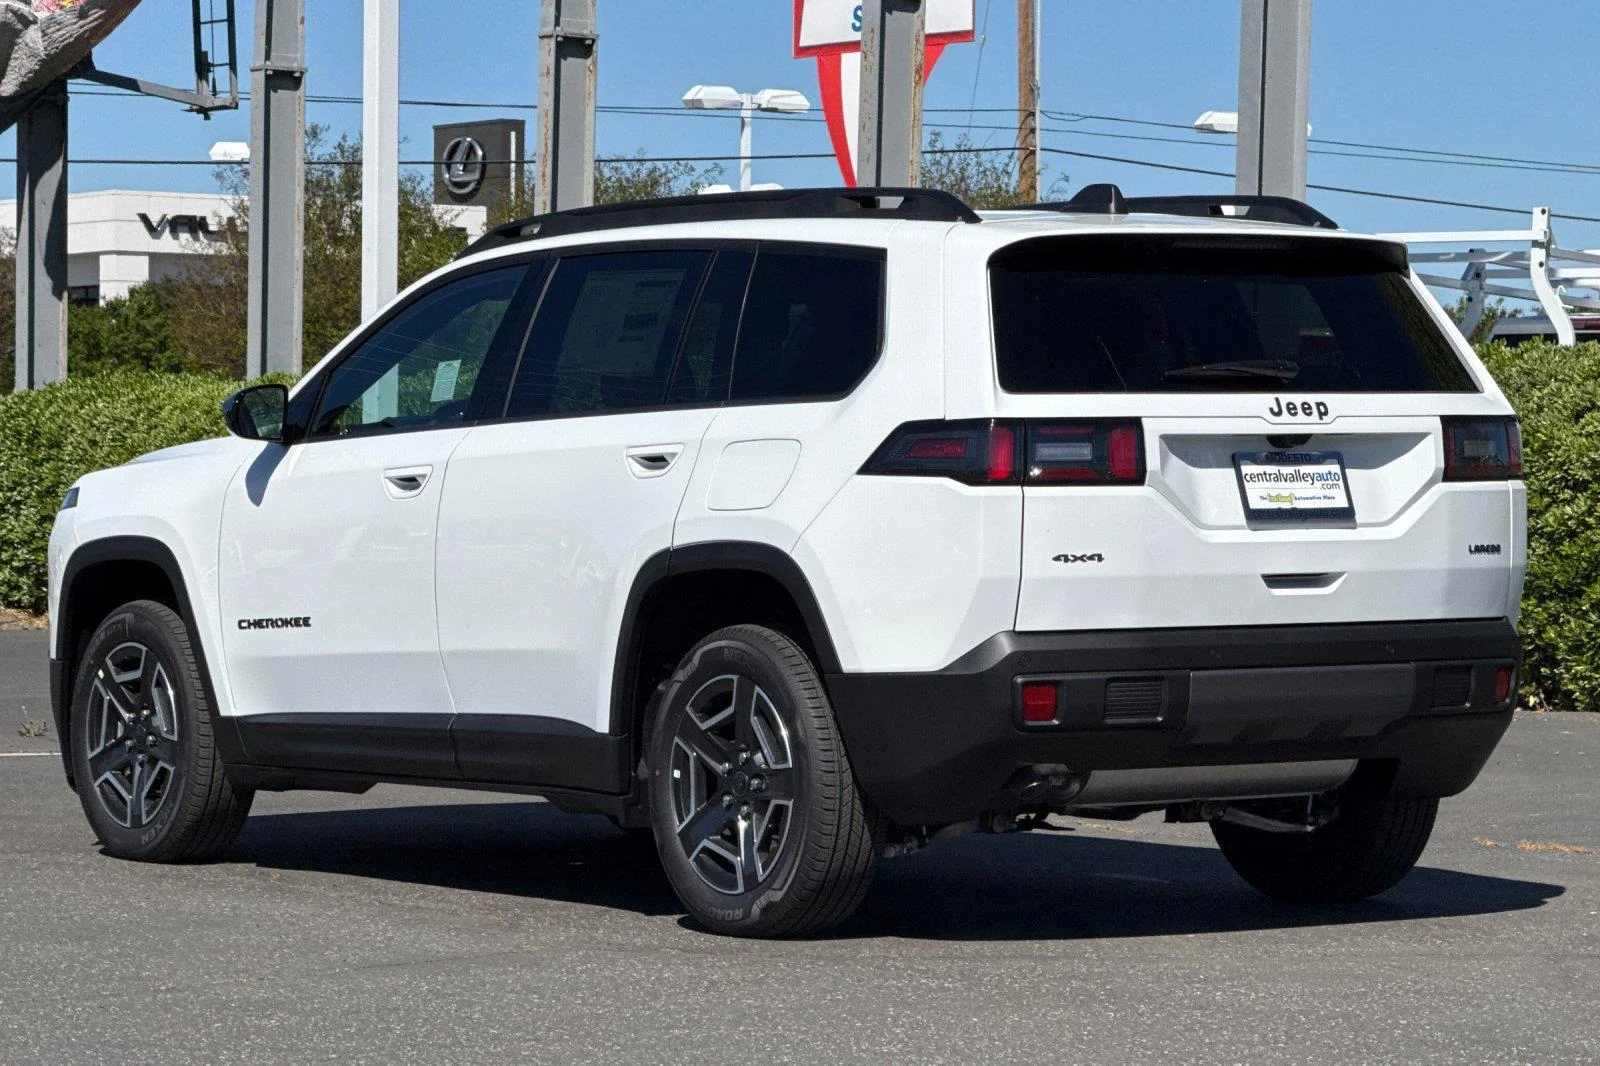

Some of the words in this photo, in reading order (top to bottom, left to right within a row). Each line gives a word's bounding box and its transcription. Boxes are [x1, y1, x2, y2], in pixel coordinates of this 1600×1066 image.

[1268, 396, 1329, 421] Jeep
[1265, 452, 1311, 463] MODESTO
[1243, 469, 1340, 485] centralvalleyauto
[1318, 483, 1341, 491] .com
[1468, 544, 1501, 555] LAREDO
[237, 616, 311, 630] CHEROKEE
